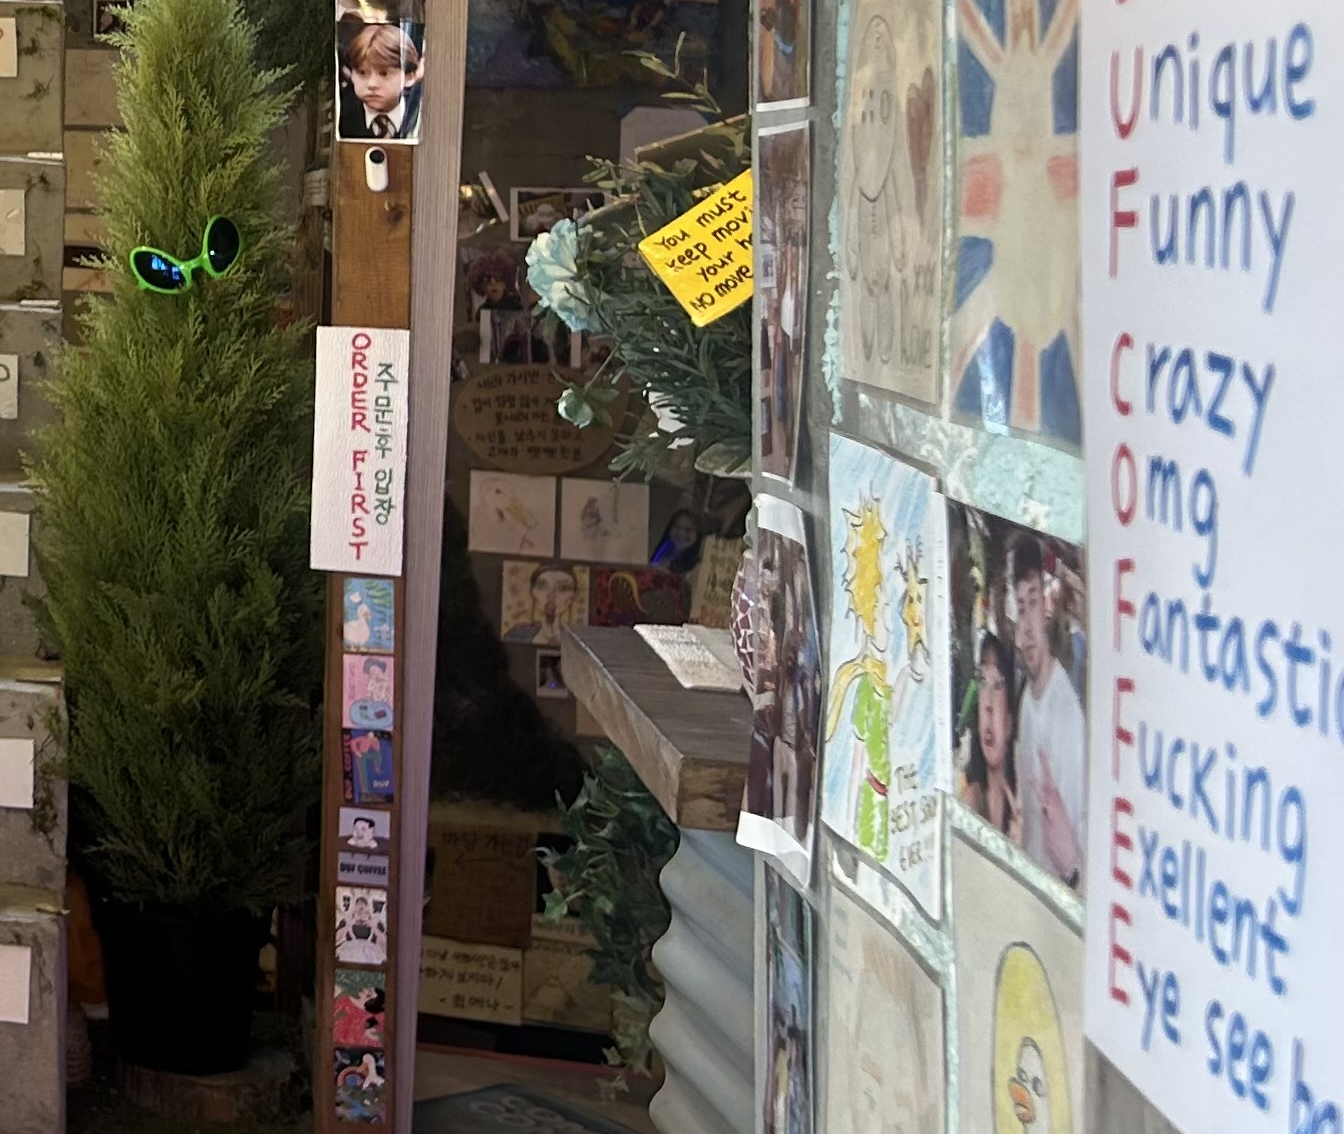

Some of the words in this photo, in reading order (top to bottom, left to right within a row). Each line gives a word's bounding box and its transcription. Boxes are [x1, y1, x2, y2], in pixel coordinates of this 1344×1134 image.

[1110, 22, 1317, 165] Unique
[654, 229, 692, 252] You
[695, 189, 747, 228] must
[665, 241, 713, 273] keep
[1108, 166, 1297, 317] Funny
[350, 333, 372, 434] ORDER
[374, 362, 399, 460] 주문후
[1110, 330, 1277, 478] Crazy
[348, 449, 370, 561] FIRST
[374, 468, 396, 526] 입장
[1111, 442, 1219, 590] Omg
[1112, 676, 1307, 919] Fucking
[1111, 796, 1290, 998] Exellent
[1108, 902, 1183, 1054] Eye
[1203, 998, 1274, 1112] see
